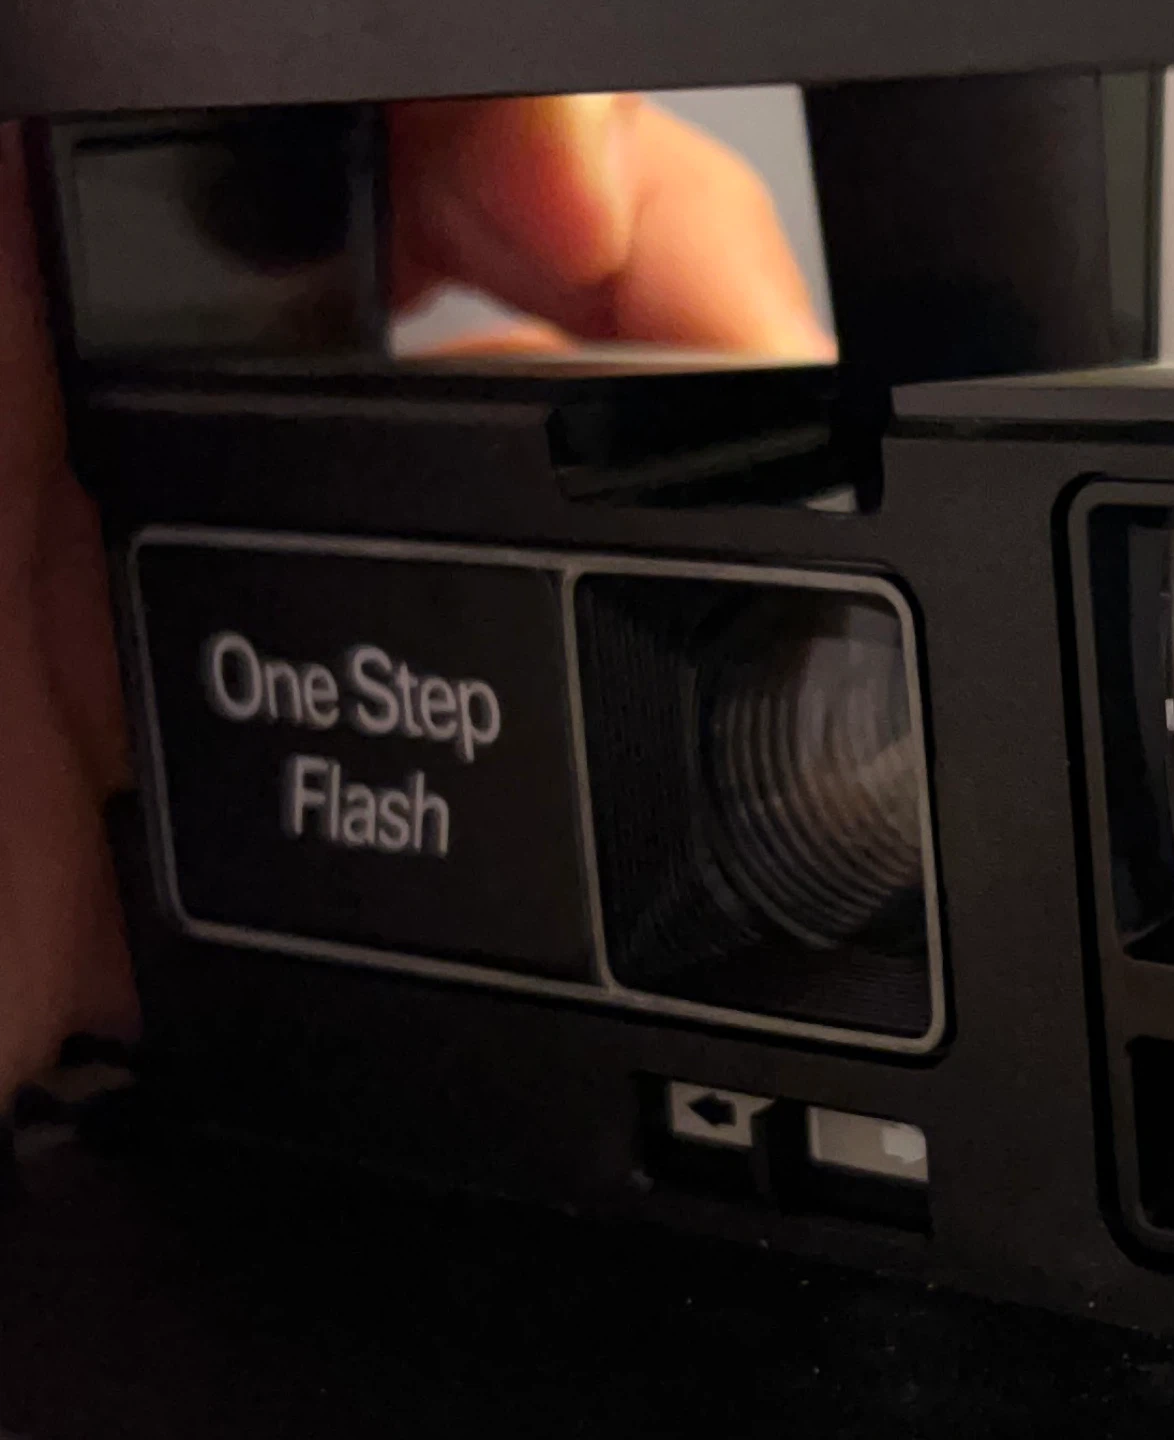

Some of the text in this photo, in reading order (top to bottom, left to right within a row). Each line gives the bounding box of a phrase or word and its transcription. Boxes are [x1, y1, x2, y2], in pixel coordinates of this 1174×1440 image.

[210, 633, 501, 762] One Step
[290, 756, 450, 856] Flash
